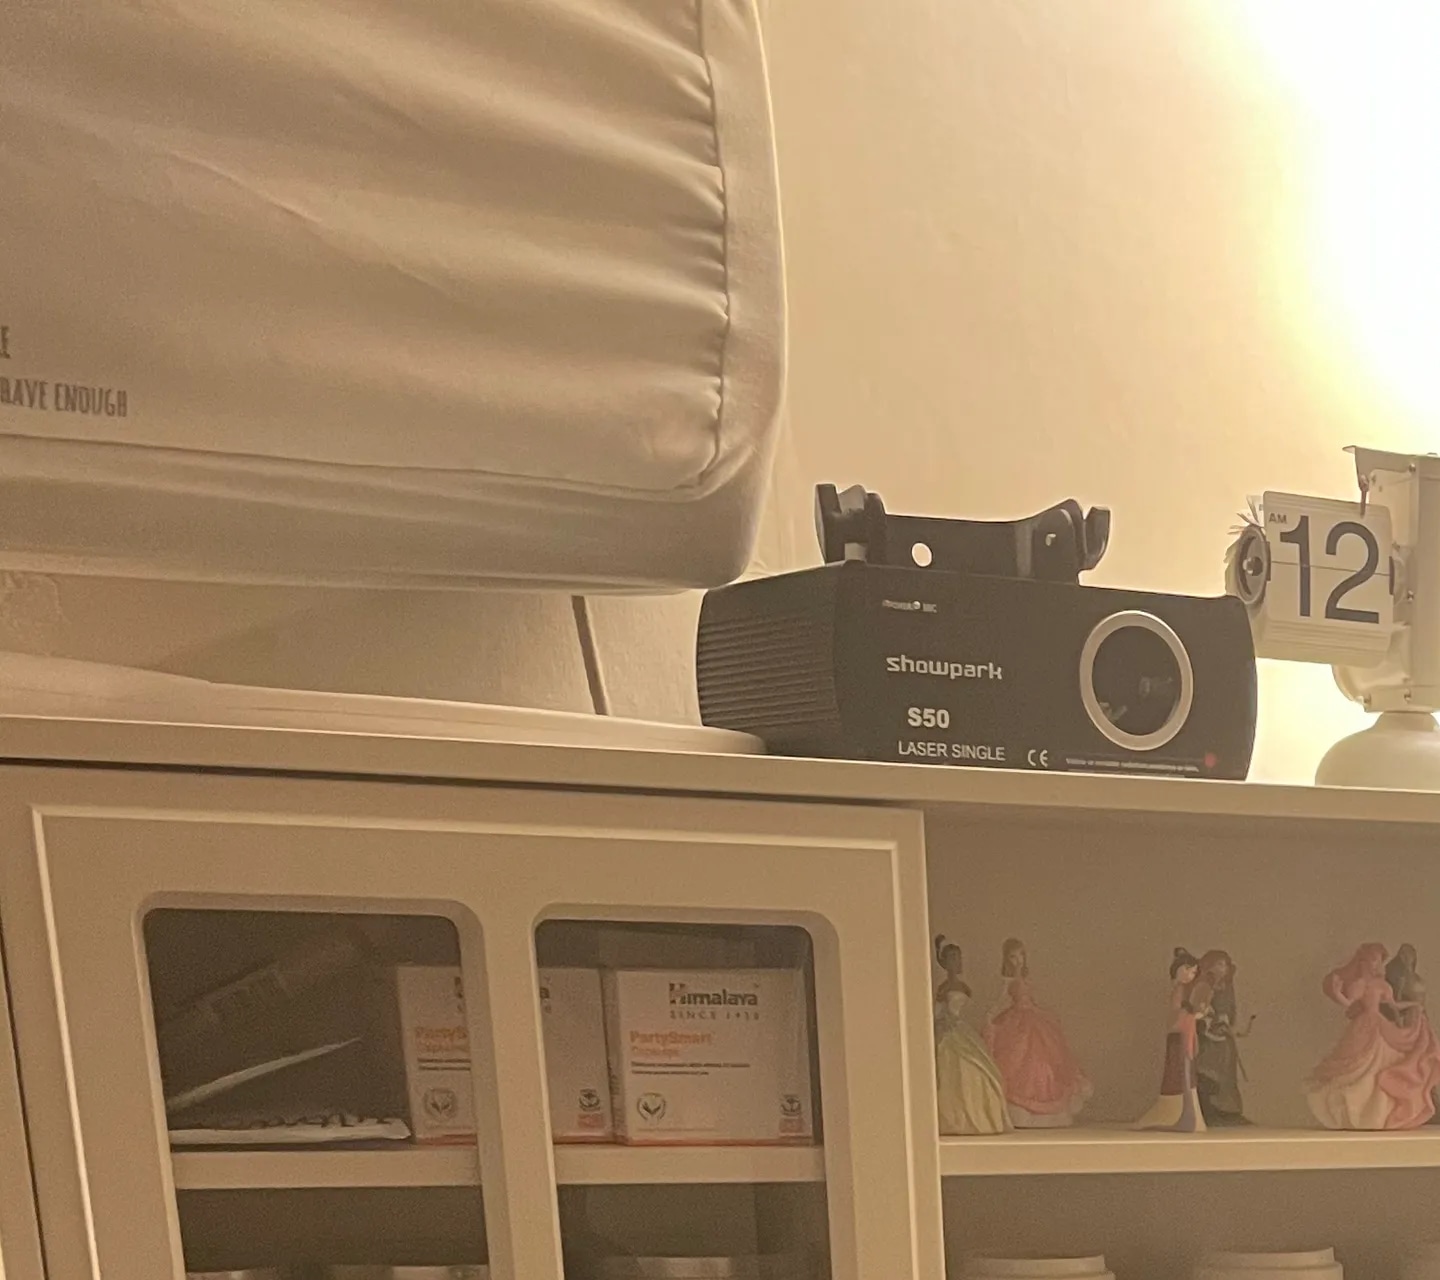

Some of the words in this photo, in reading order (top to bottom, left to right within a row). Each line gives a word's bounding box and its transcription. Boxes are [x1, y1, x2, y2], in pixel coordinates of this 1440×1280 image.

[54, 383, 127, 417] ENOUGH
[1269, 513, 1287, 525] AM
[1278, 515, 1380, 625] 12
[886, 654, 1003, 680] showpark
[907, 706, 950, 729] S50
[898, 740, 948, 758] LASER
[951, 743, 1006, 762] SINGLE
